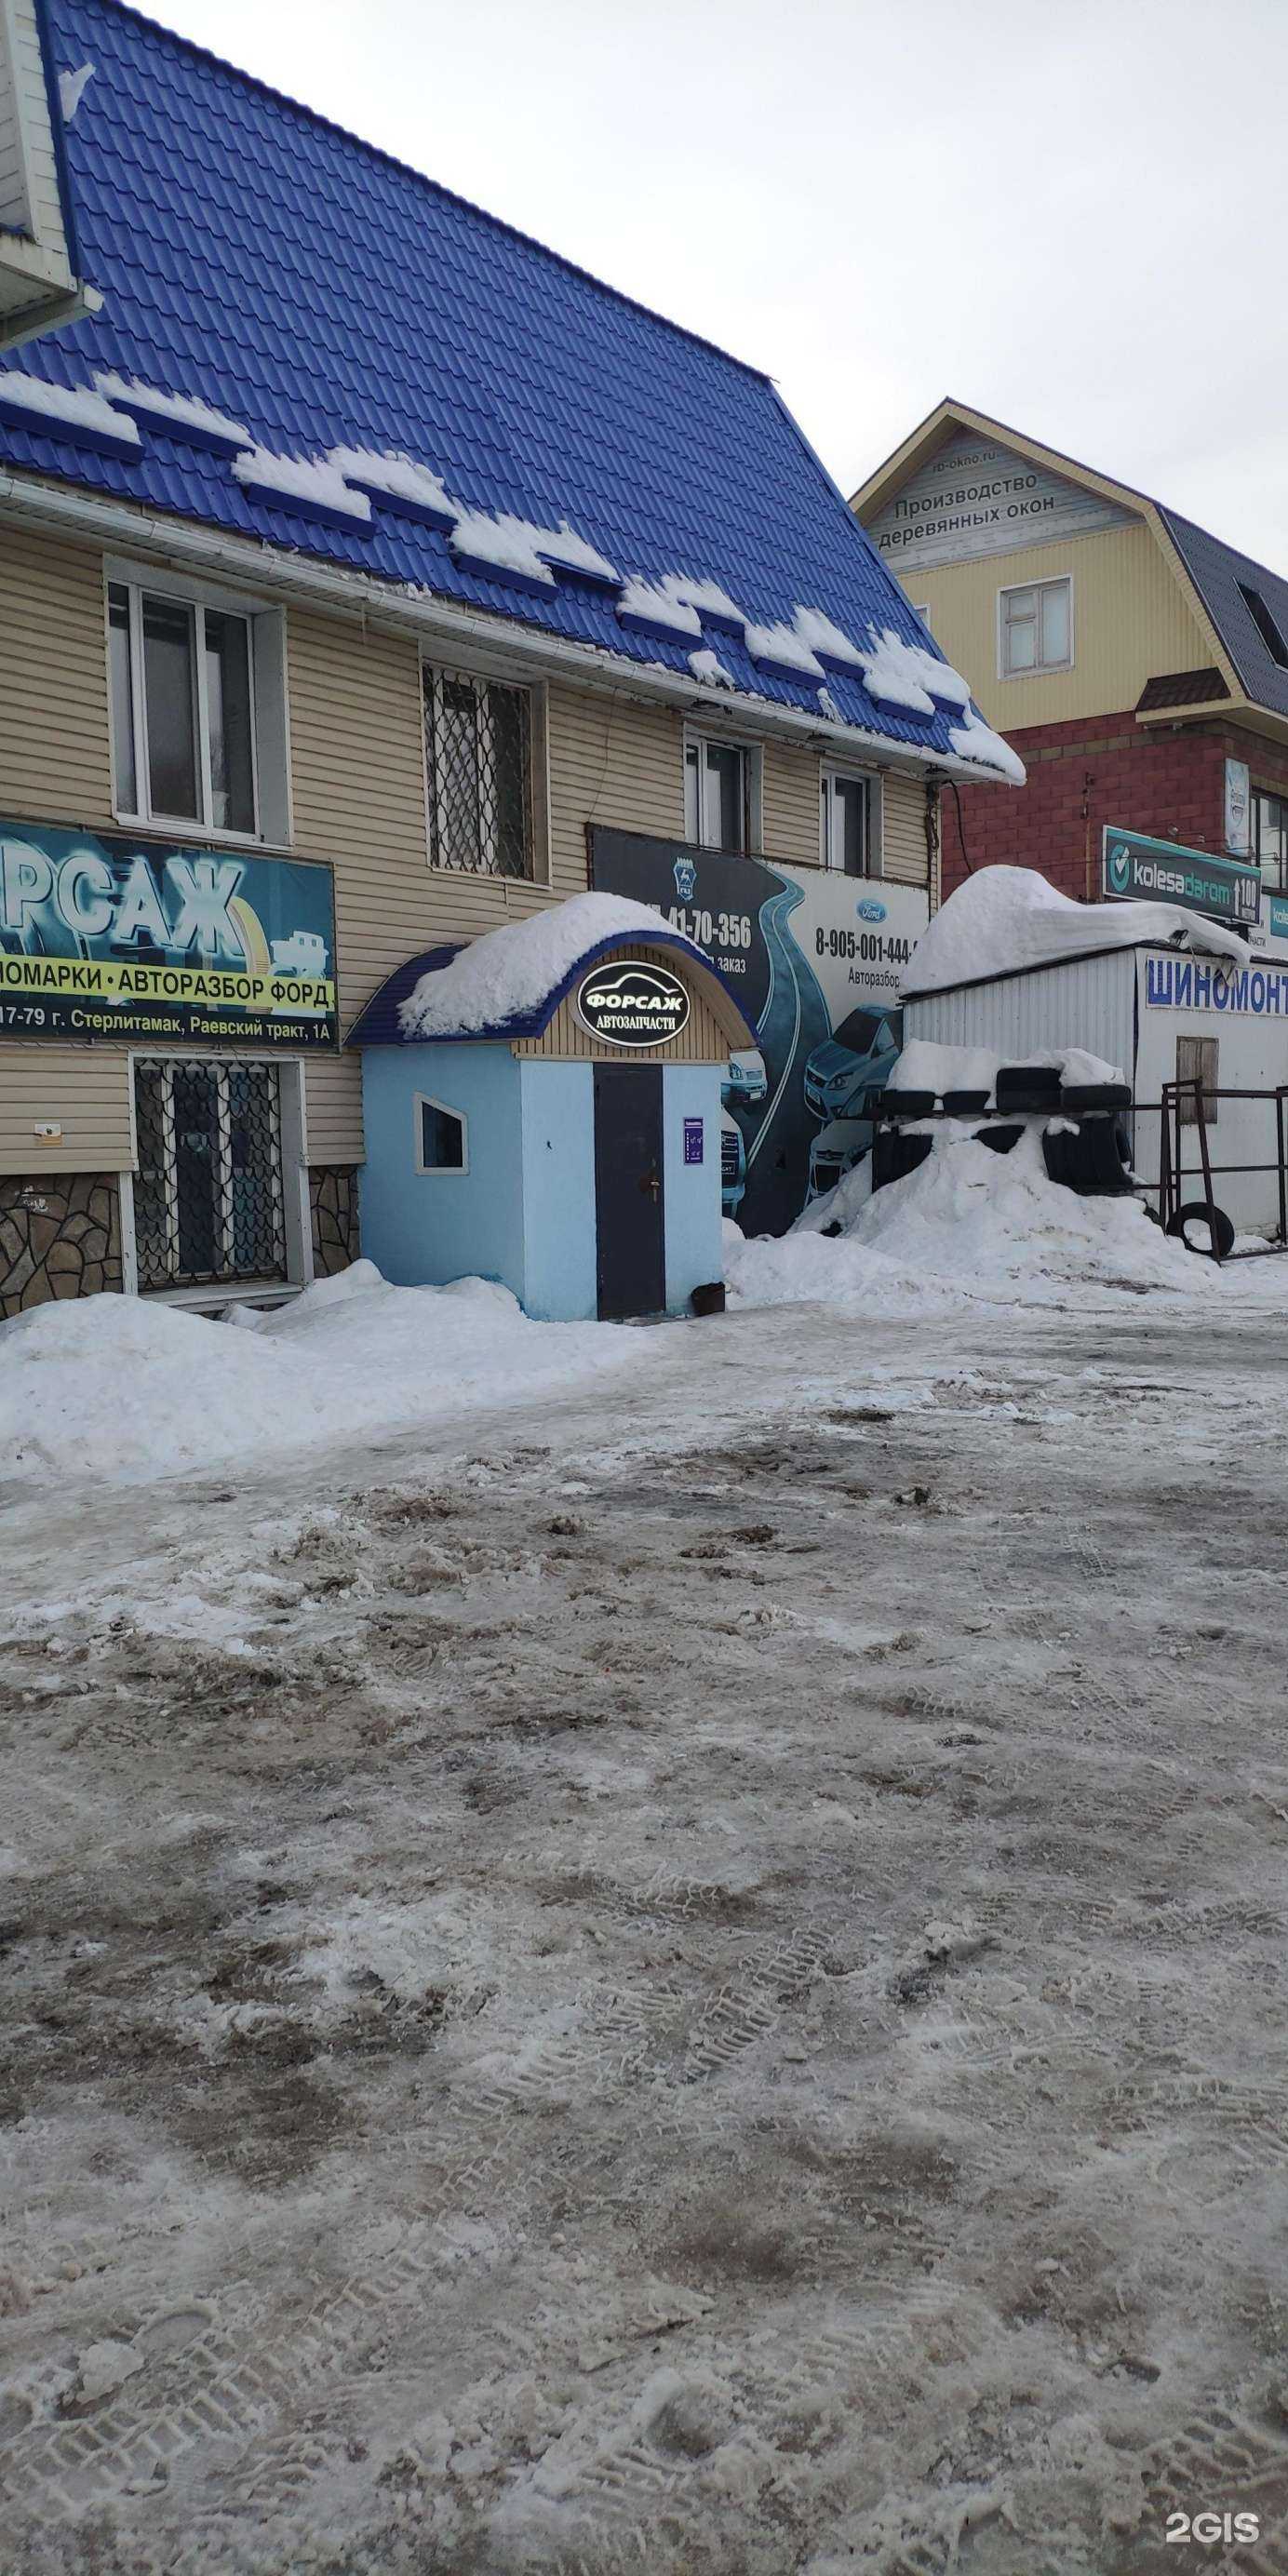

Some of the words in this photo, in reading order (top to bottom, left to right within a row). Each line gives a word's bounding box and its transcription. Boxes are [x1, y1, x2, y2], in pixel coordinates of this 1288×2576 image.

[894, 474, 1038, 519] Производство
[879, 506, 1001, 551] деревянных
[1006, 496, 1054, 518] окон
[0, 837, 247, 958] РСАЖ
[1134, 858, 1229, 906] kolesadarom
[1241, 878, 1256, 908] 100
[862, 901, 882, 919] Ford
[717, 957, 746, 973] заказ
[848, 966, 901, 989] Авторазбор
[118, 969, 264, 1000] АВТОРАЗБОР
[271, 981, 329, 1009] ФОРД
[586, 993, 683, 1012] ФОРСАЖ
[52, 1012, 65, 1026] г.
[71, 1009, 185, 1036] Стерлитамак,
[190, 1015, 262, 1037] Раевский
[266, 1024, 309, 1041] тракт,
[313, 1023, 330, 1040] 1А
[597, 1014, 677, 1030] АВТОЗАПЧАСТИ
